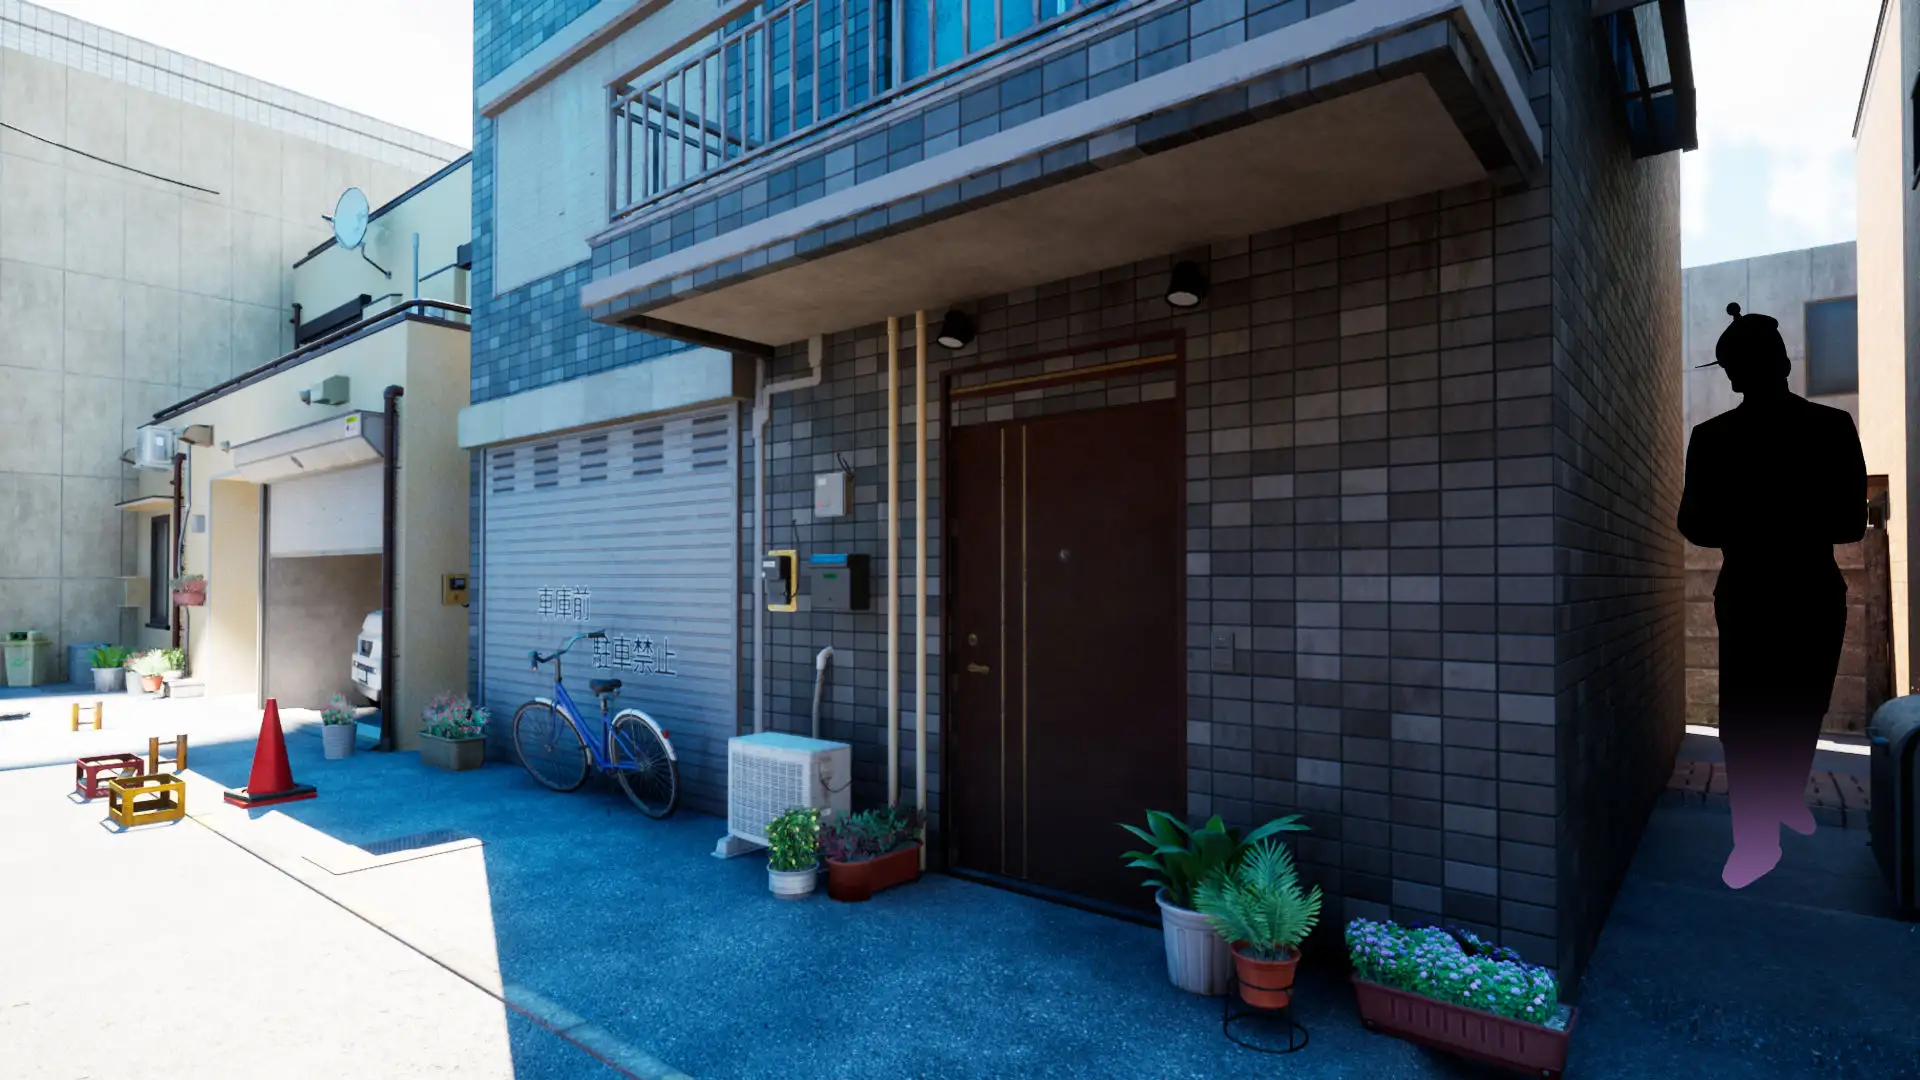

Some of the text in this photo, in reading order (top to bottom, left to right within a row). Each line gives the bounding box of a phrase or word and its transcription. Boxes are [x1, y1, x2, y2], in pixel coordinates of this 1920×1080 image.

[538, 585, 590, 621] 車庫前
[592, 634, 676, 675] 駐車禁止
